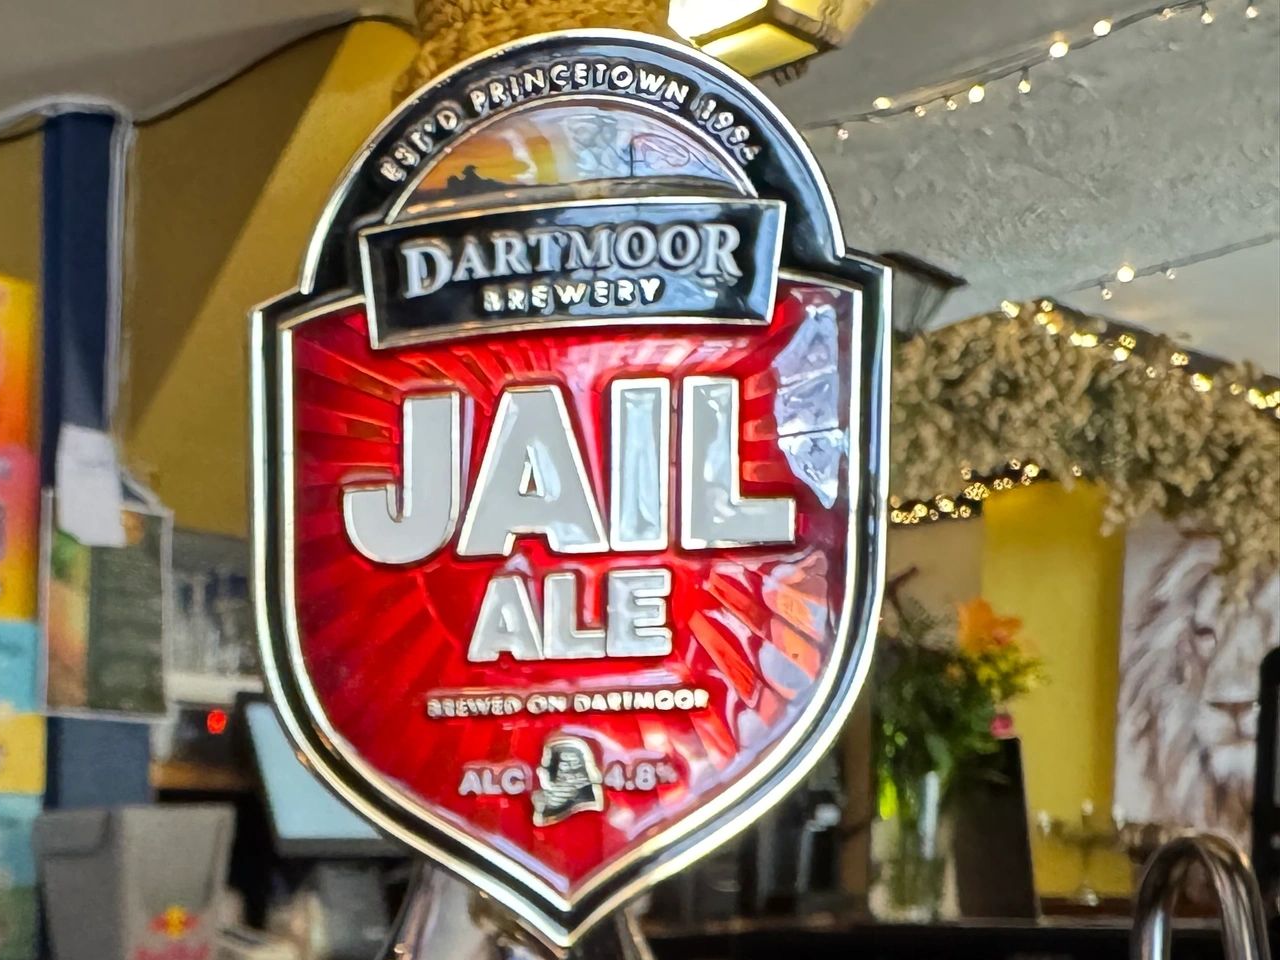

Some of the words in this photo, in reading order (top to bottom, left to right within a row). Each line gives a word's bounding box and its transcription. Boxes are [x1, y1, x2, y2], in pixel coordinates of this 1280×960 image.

[469, 62, 690, 112] PRINCETOWN
[401, 222, 744, 300] DARTMOOR
[482, 277, 662, 313] BREWERY
[341, 375, 797, 565] JAIL
[466, 568, 673, 663] ALE
[426, 695, 522, 718] BREWED
[526, 693, 568, 714] ON
[573, 688, 709, 713] DARTMOOR
[457, 766, 527, 796] ALC
